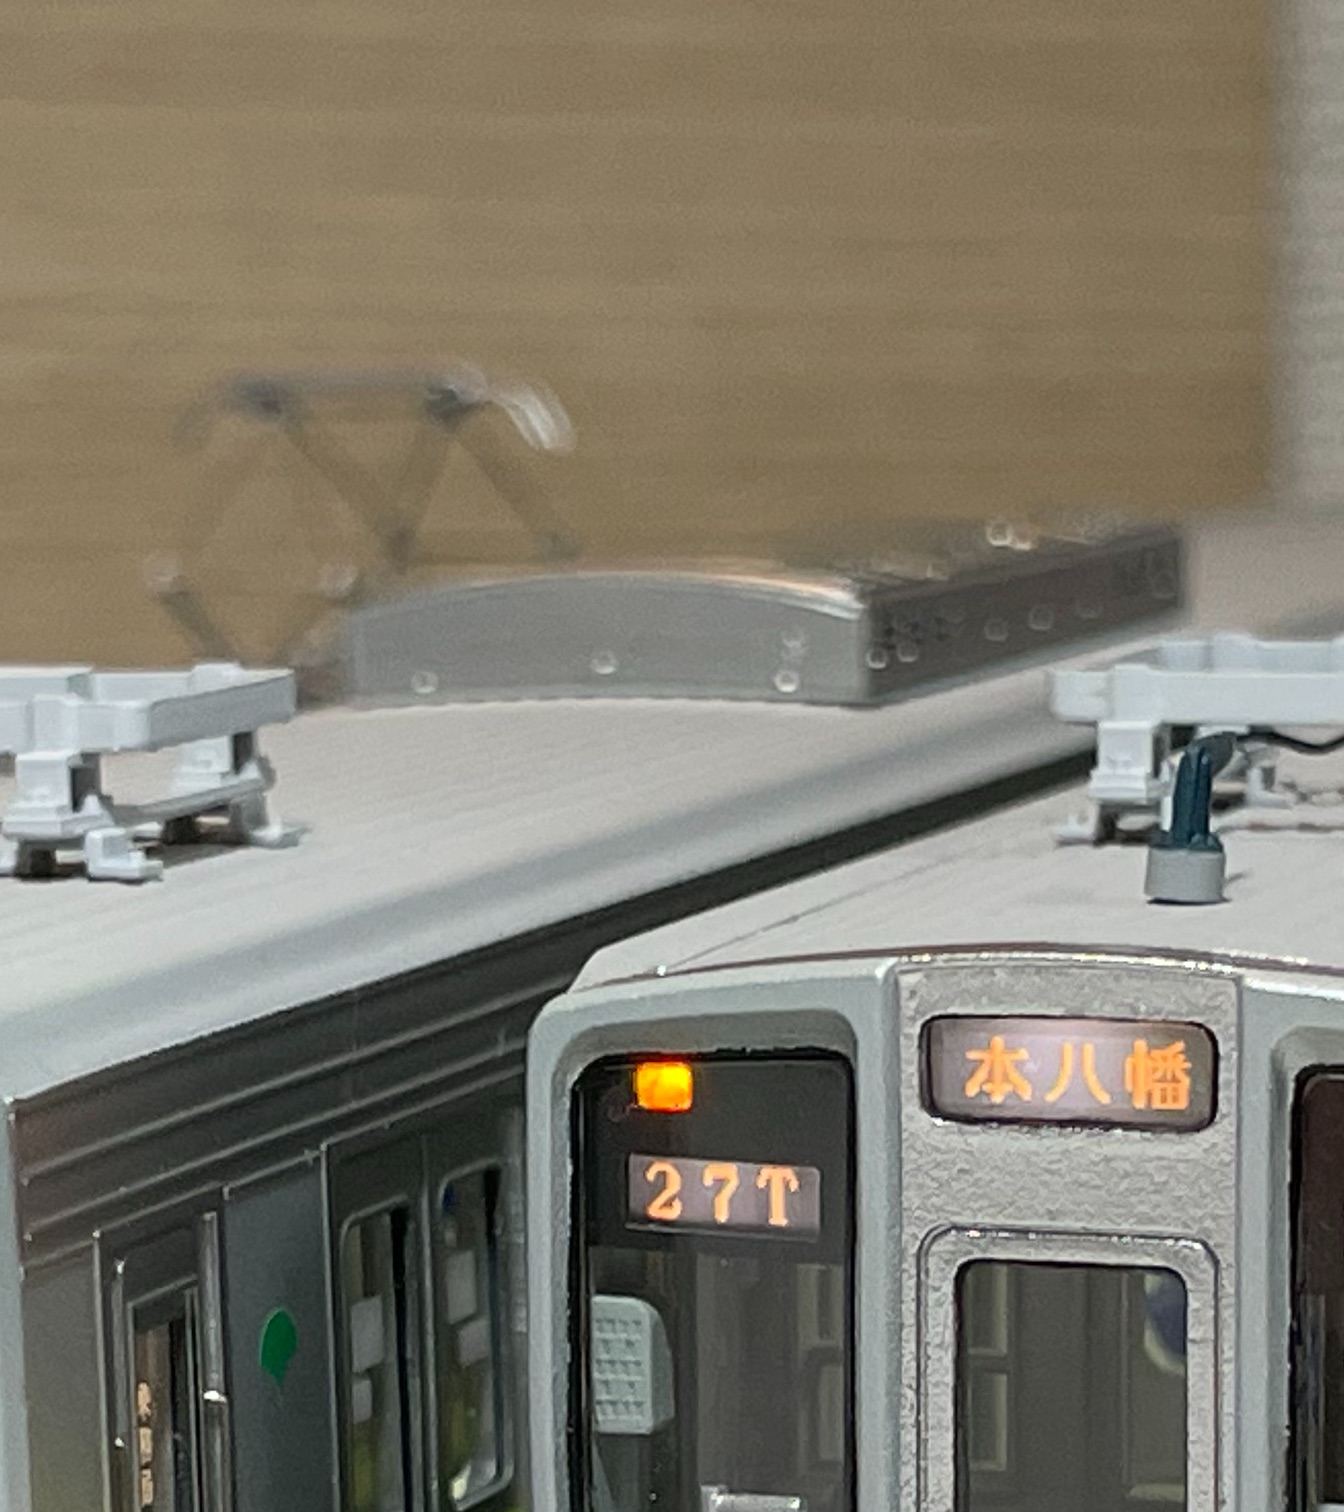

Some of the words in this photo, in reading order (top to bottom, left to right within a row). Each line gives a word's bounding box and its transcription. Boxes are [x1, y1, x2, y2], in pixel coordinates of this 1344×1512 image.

[964, 1035, 1192, 1110] 本八幡
[644, 1161, 799, 1227] 27T
